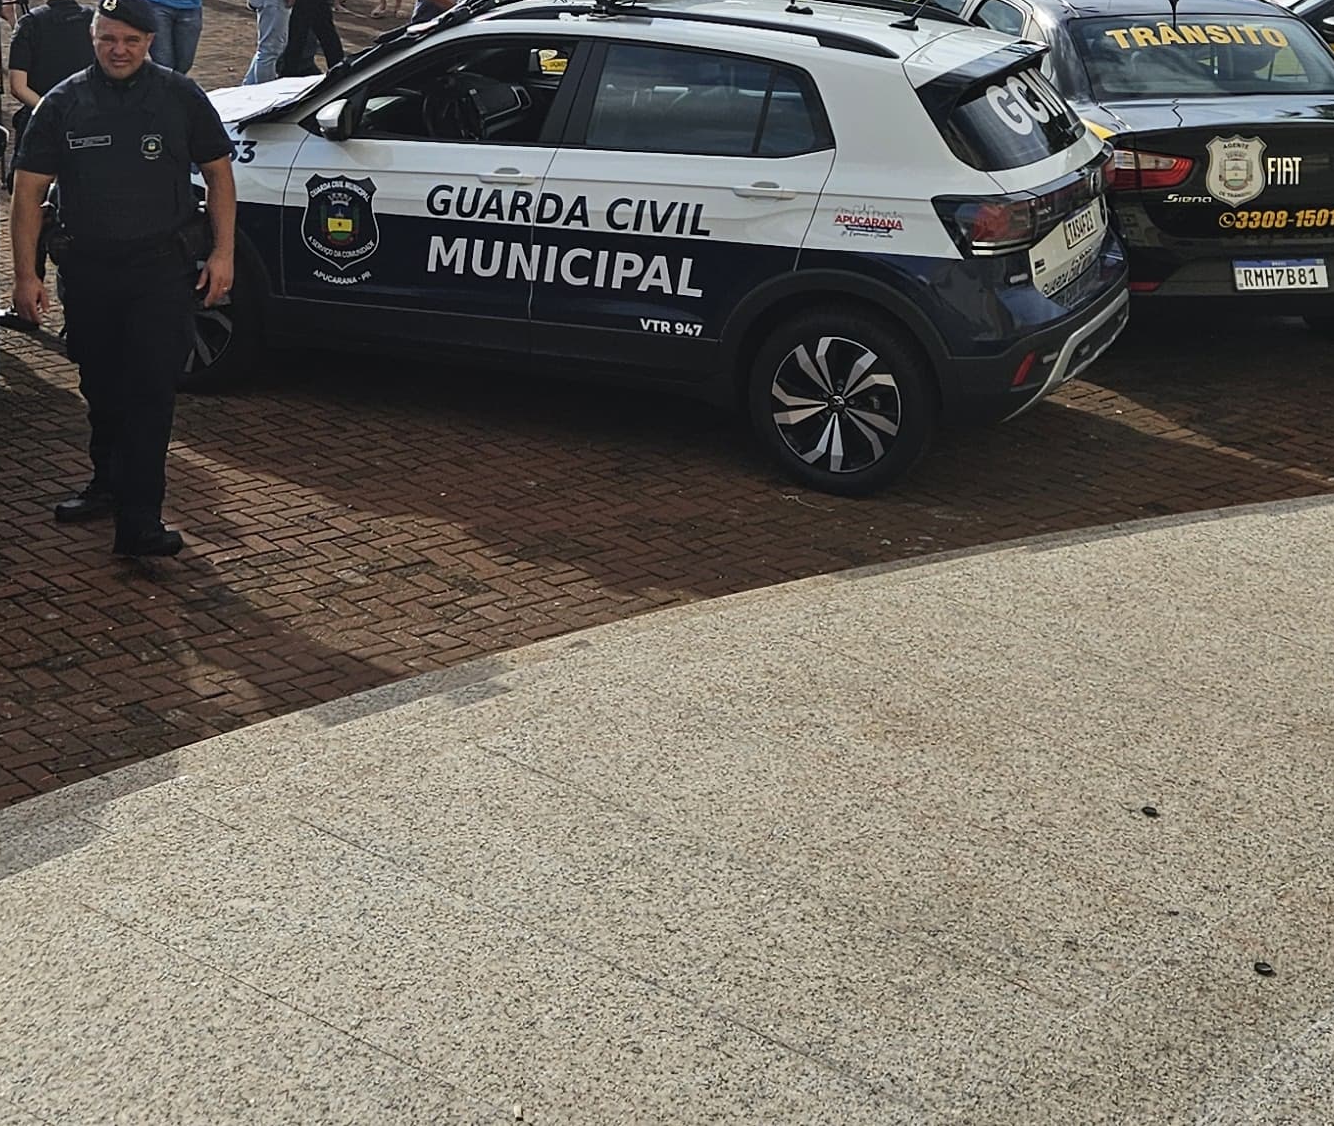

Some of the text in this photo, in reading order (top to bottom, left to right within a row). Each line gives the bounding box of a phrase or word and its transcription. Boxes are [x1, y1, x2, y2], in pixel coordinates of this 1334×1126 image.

[1105, 21, 1289, 50] TRÂNSITO
[986, 67, 1068, 136] GCM
[229, 140, 258, 164] 53
[1222, 142, 1250, 150] AGENTE
[1267, 157, 1302, 186] FIAT
[309, 181, 331, 198] GUARDA
[331, 179, 345, 189] CIVIL
[1163, 193, 1212, 204] Siena
[426, 184, 711, 237] GUARDA CIVIL
[834, 214, 903, 229] APUCARANA
[426, 235, 704, 298] MUNICIPAL
[313, 269, 372, 285] APUCARANA PR
[1243, 268, 1319, 288] RMH7B81
[639, 317, 704, 337] VTR 947
